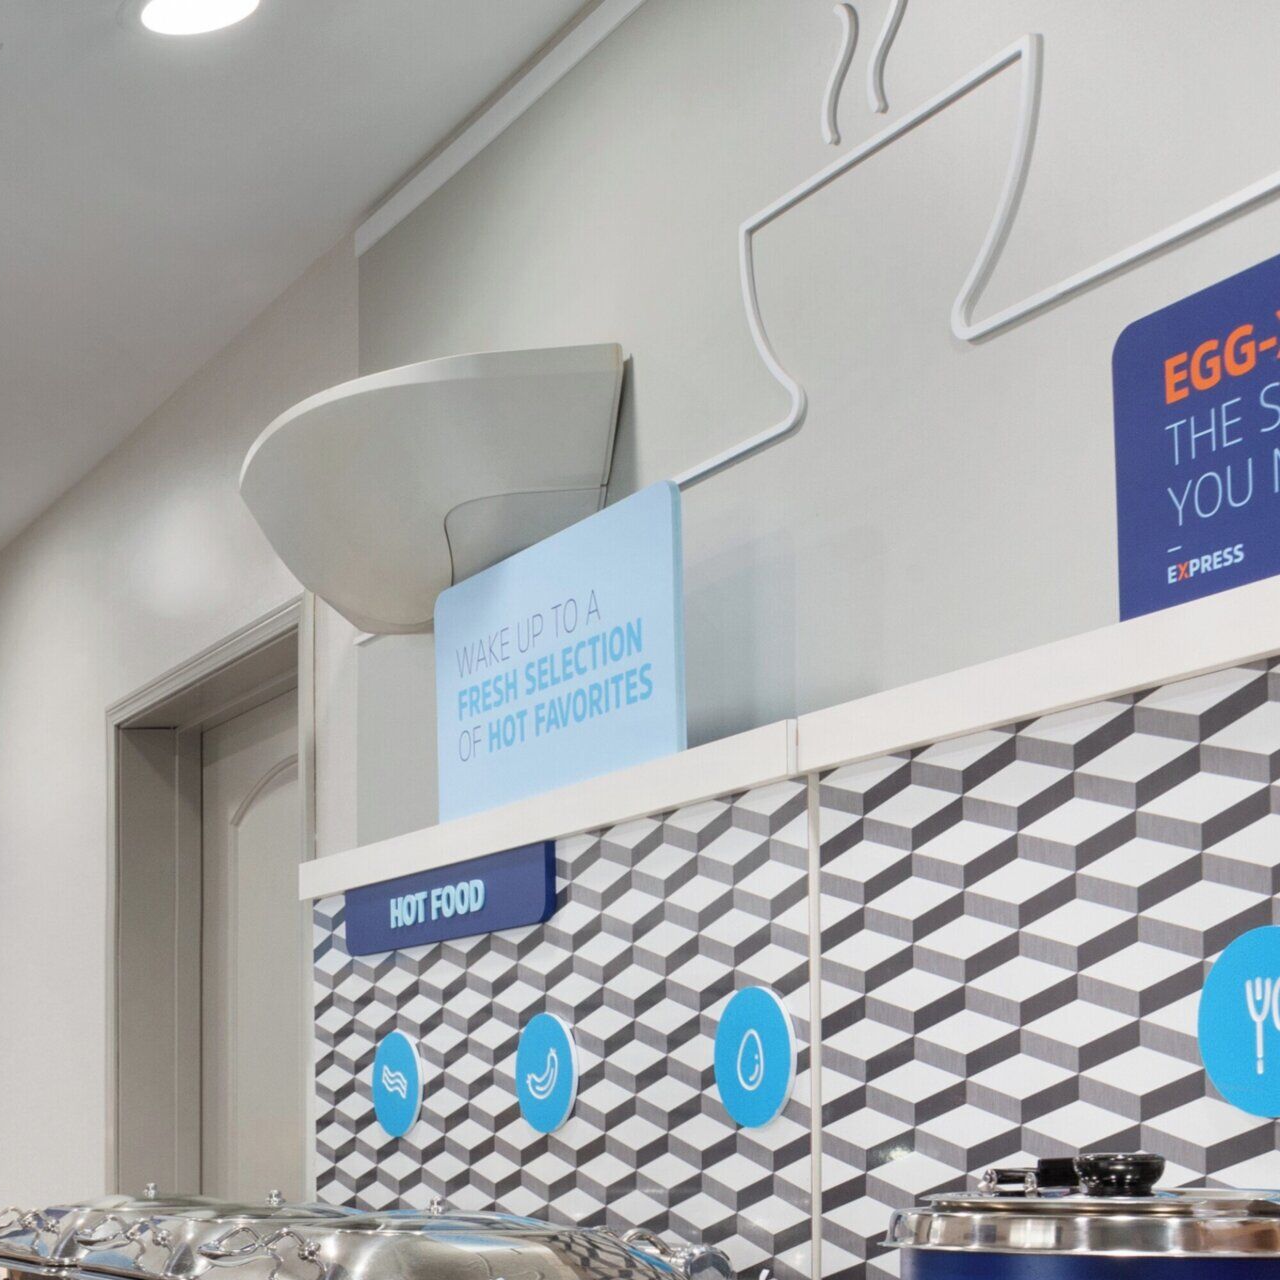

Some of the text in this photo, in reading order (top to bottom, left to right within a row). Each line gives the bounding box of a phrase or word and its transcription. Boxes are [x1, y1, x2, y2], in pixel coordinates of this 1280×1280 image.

[1165, 309, 1280, 404] EGG-
[1165, 397, 1242, 466] THE
[1167, 457, 1253, 526] YOU
[1167, 544, 1244, 584] EXPRESS
[456, 589, 601, 678] WAKE UP TO A
[458, 617, 643, 721] FRESH SELECTION
[458, 663, 653, 762] OF HOT FAVORITES
[390, 879, 485, 929] HOT FOOD
